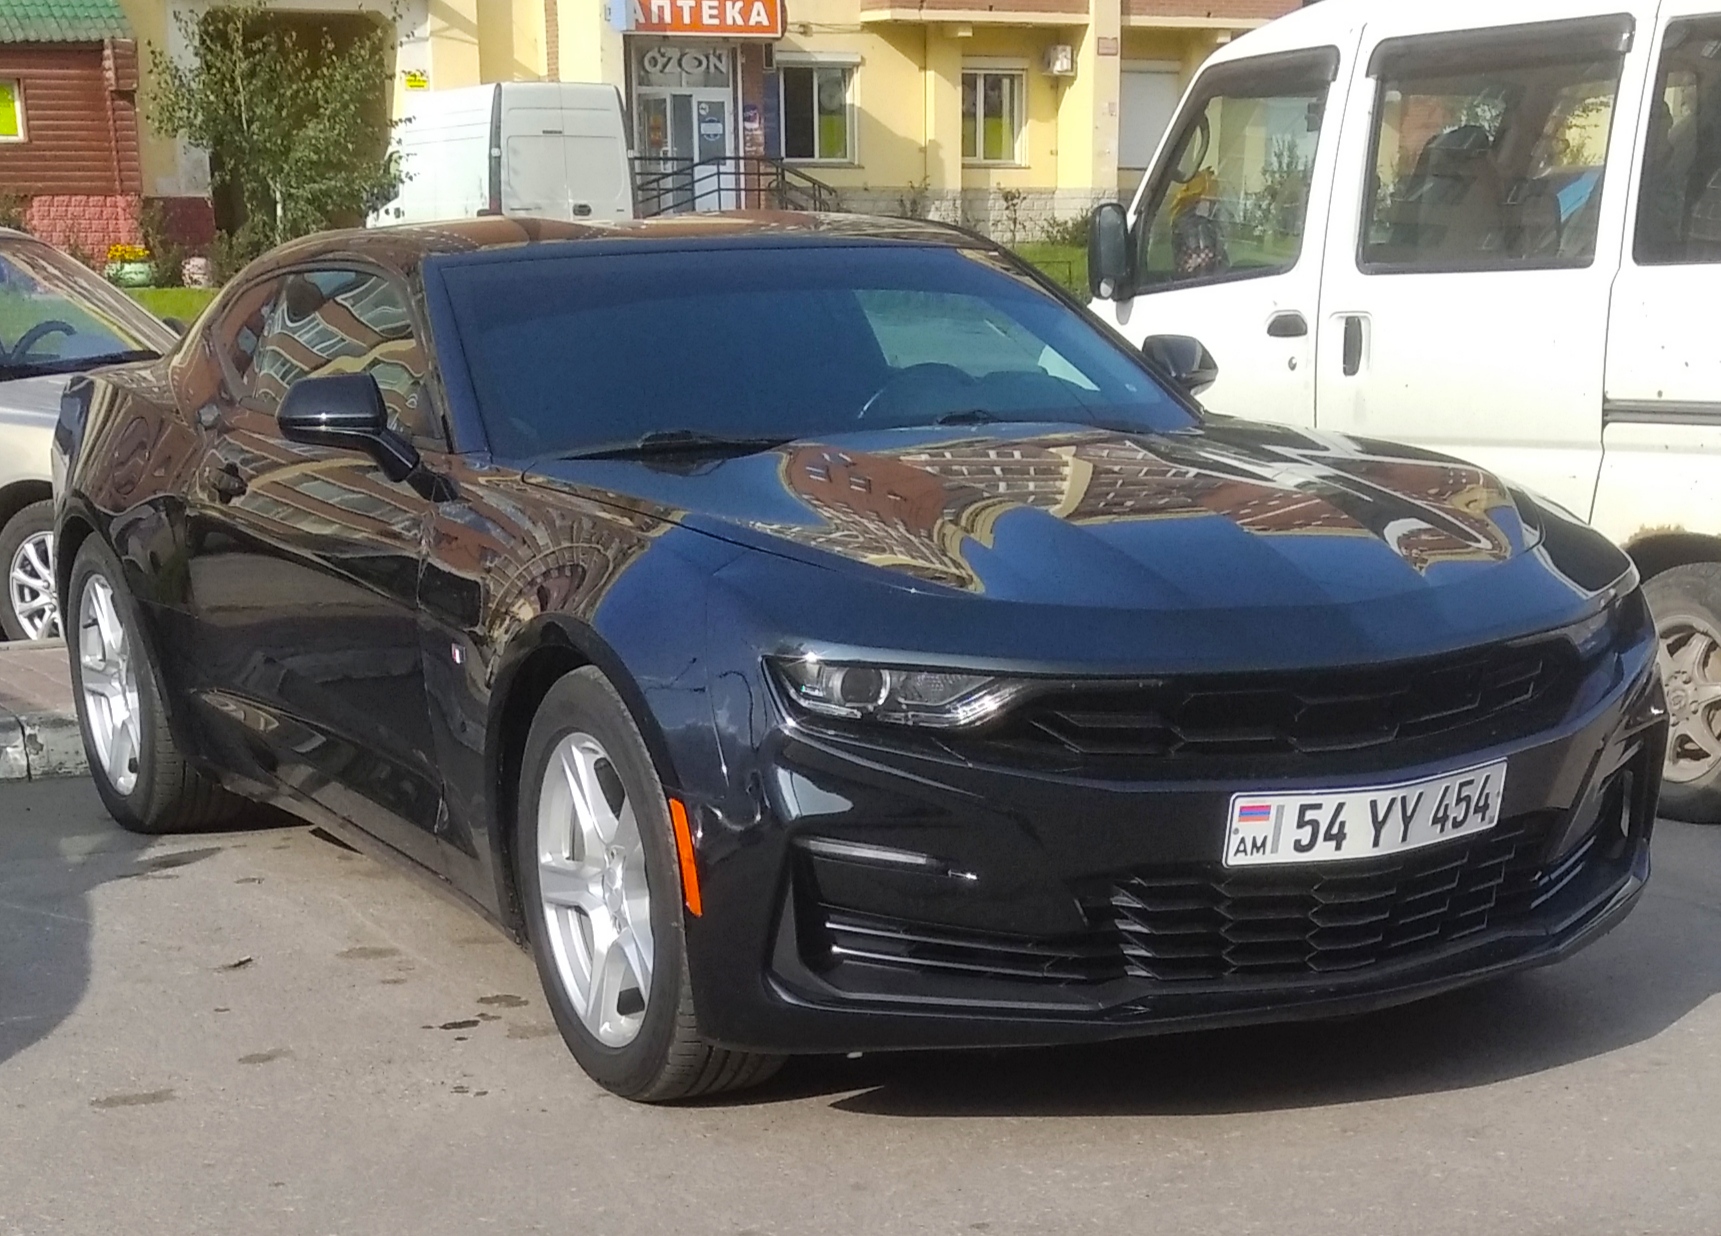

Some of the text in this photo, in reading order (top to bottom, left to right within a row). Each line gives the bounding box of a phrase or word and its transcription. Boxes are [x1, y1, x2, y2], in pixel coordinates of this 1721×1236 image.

[643, 47, 727, 75] OZON
[1293, 774, 1491, 853] 54 YY 454
[1234, 835, 1268, 857] AM
